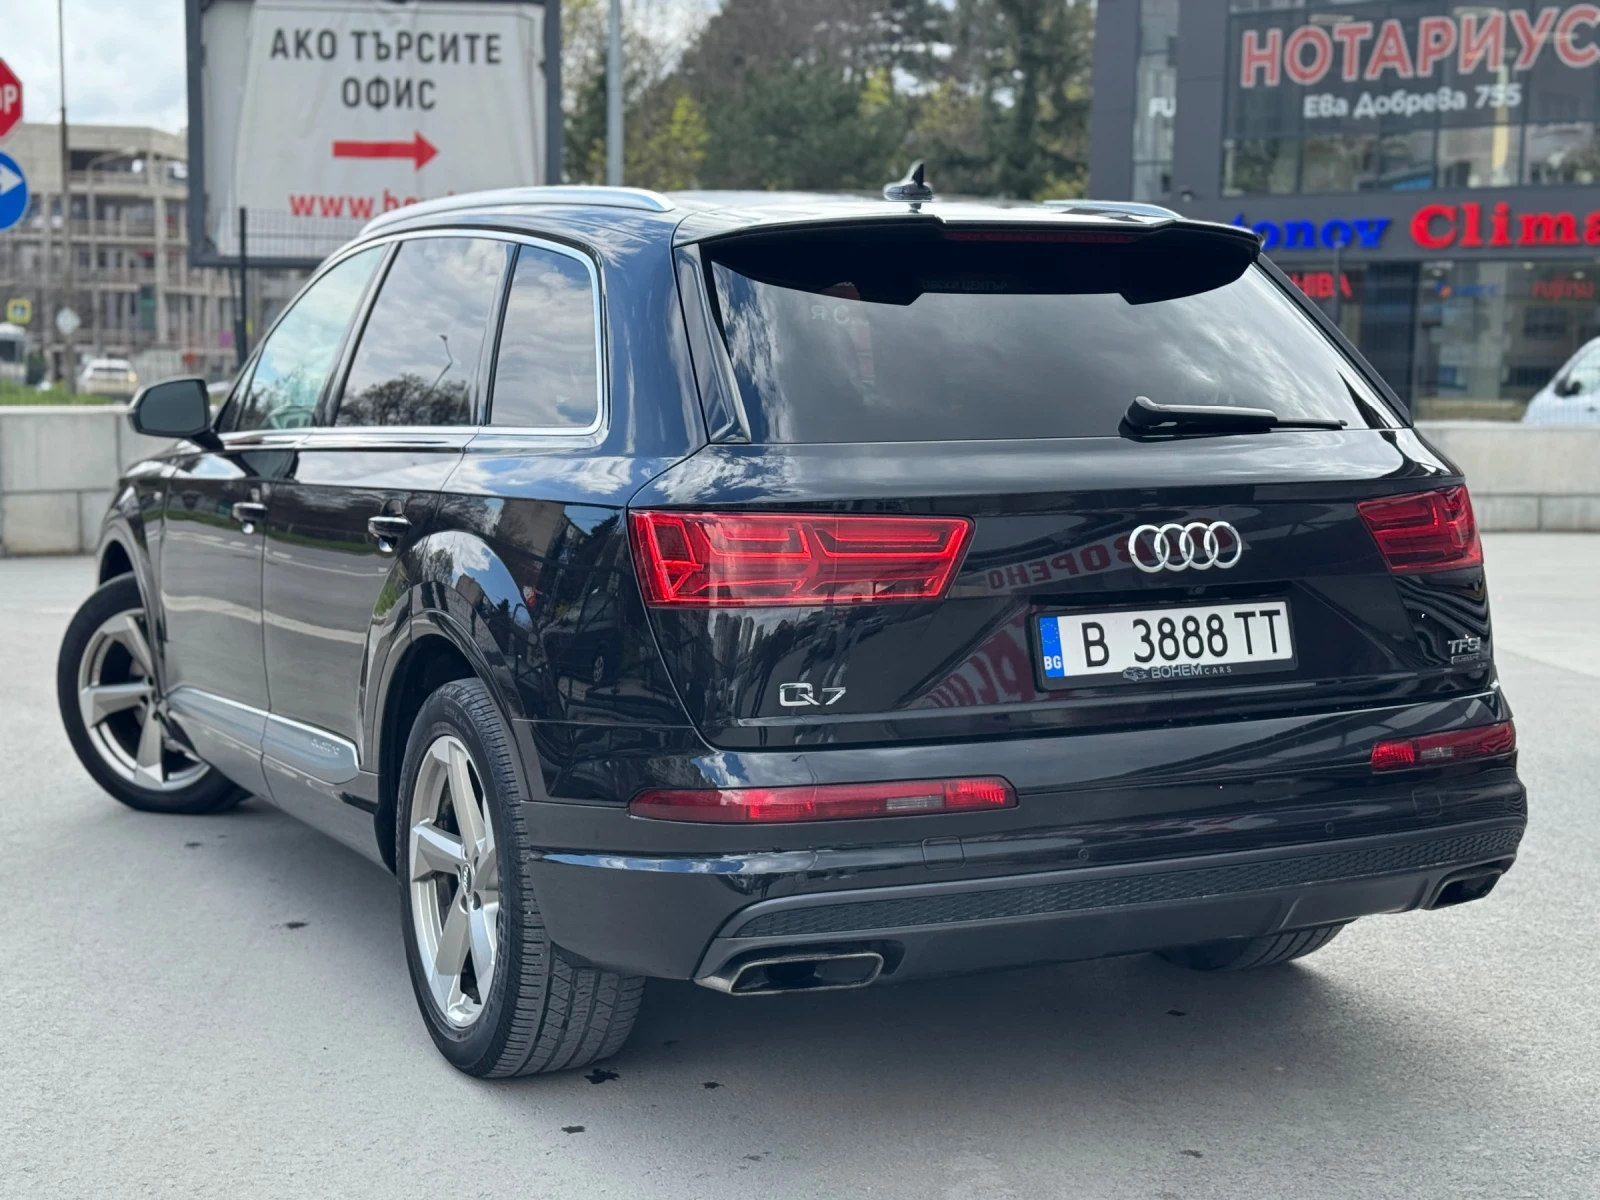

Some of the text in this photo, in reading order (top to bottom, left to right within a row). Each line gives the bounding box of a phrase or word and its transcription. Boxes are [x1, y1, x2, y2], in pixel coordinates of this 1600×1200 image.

[270, 27, 502, 65] АКО ТЪРСИТЕ
[1240, 3, 1600, 88] НОТАРИУС
[341, 74, 437, 111] ОФИС
[1303, 92, 1349, 119] Ева
[1353, 86, 1468, 119] Добрева
[1081, 621, 1110, 668] B
[1132, 613, 1229, 663] 3888
[1233, 609, 1281, 655] TT
[1043, 655, 1062, 670] BG
[1151, 663, 1232, 679] BOHEM CARS
[779, 682, 847, 707] Q7
